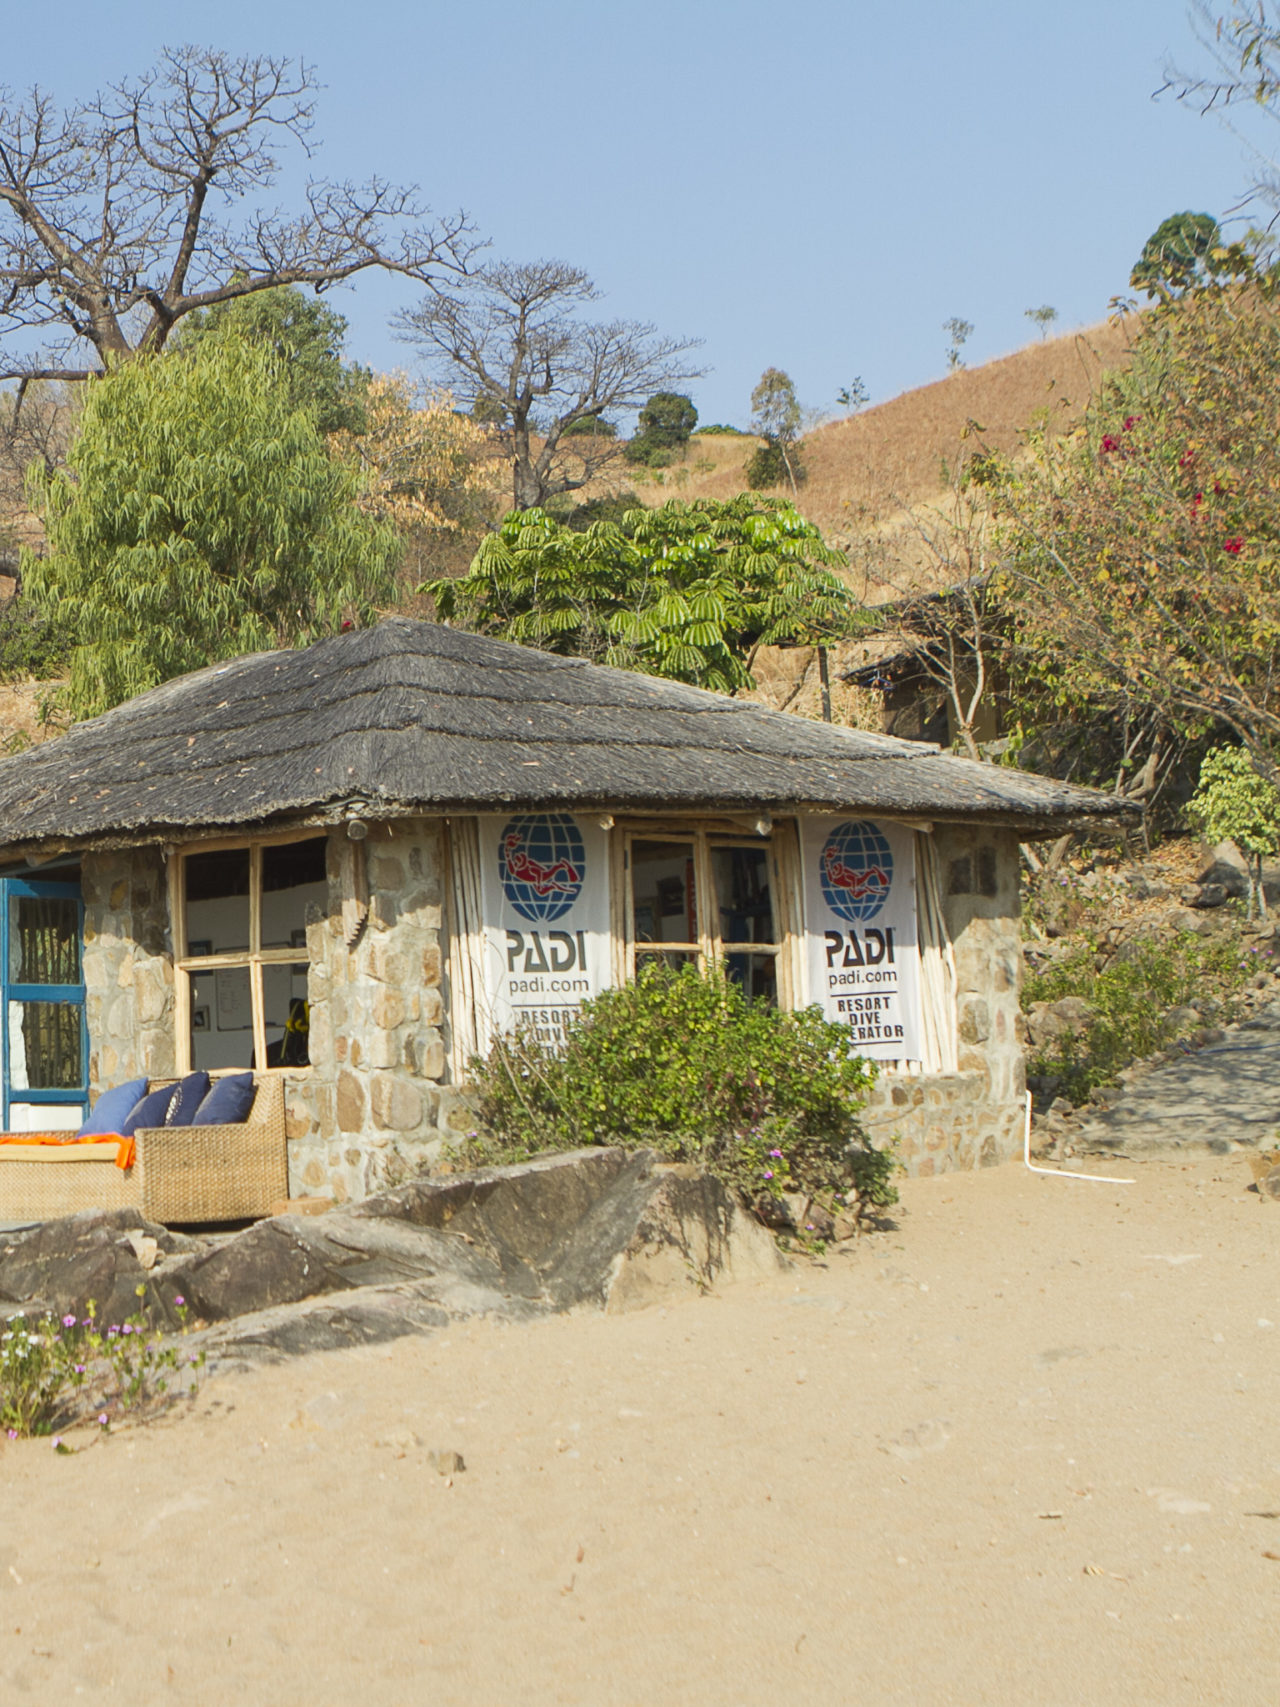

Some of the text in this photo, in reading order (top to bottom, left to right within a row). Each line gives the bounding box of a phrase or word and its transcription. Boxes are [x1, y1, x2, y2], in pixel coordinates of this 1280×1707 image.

[505, 929, 587, 973] PADI
[824, 927, 895, 968] PADI
[509, 977, 590, 996] padi.com
[828, 970, 898, 989] padi.com
[837, 996, 891, 1012] RESORT
[849, 1011, 881, 1026] DIVE
[850, 1025, 904, 1041] ERATOR
